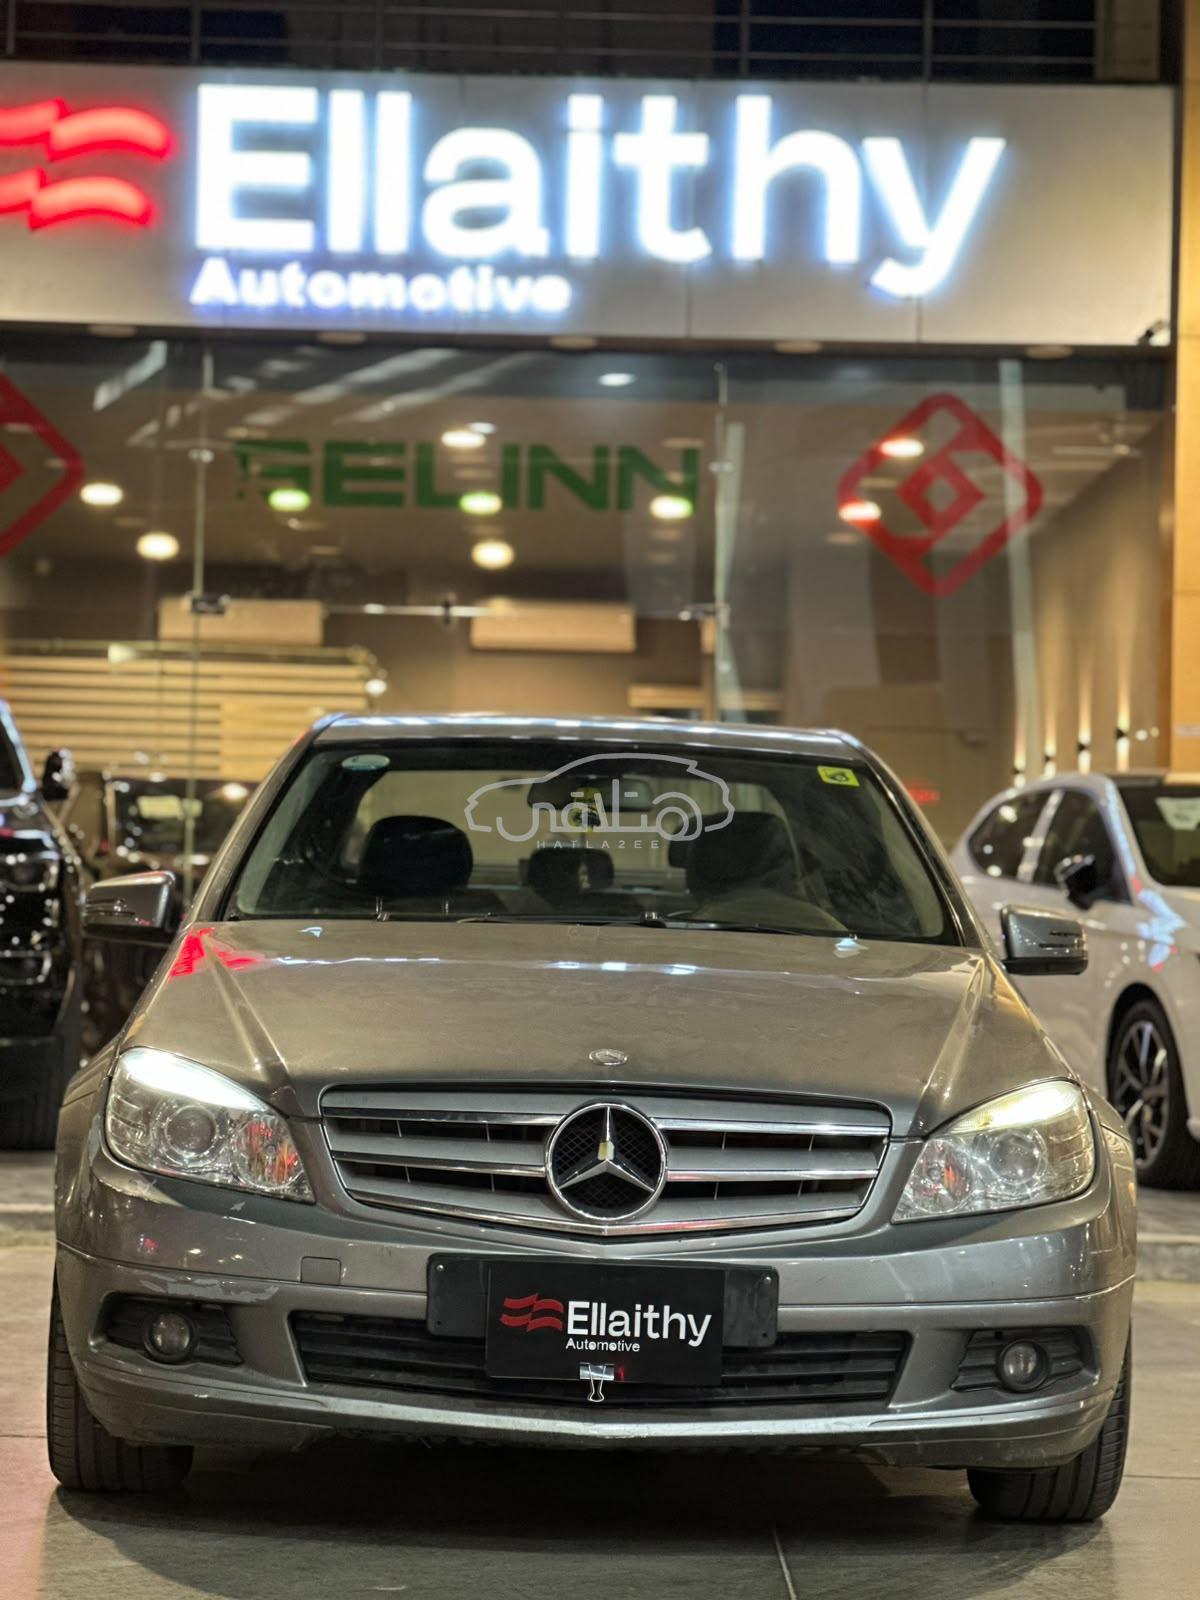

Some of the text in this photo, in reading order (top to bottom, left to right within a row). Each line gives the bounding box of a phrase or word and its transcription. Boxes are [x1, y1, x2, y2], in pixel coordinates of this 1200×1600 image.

[195, 83, 1006, 298] Ellaithy
[190, 257, 572, 312] Automotive
[565, 1337, 641, 1352] Automotive
[567, 1301, 712, 1347] Ellaithy
